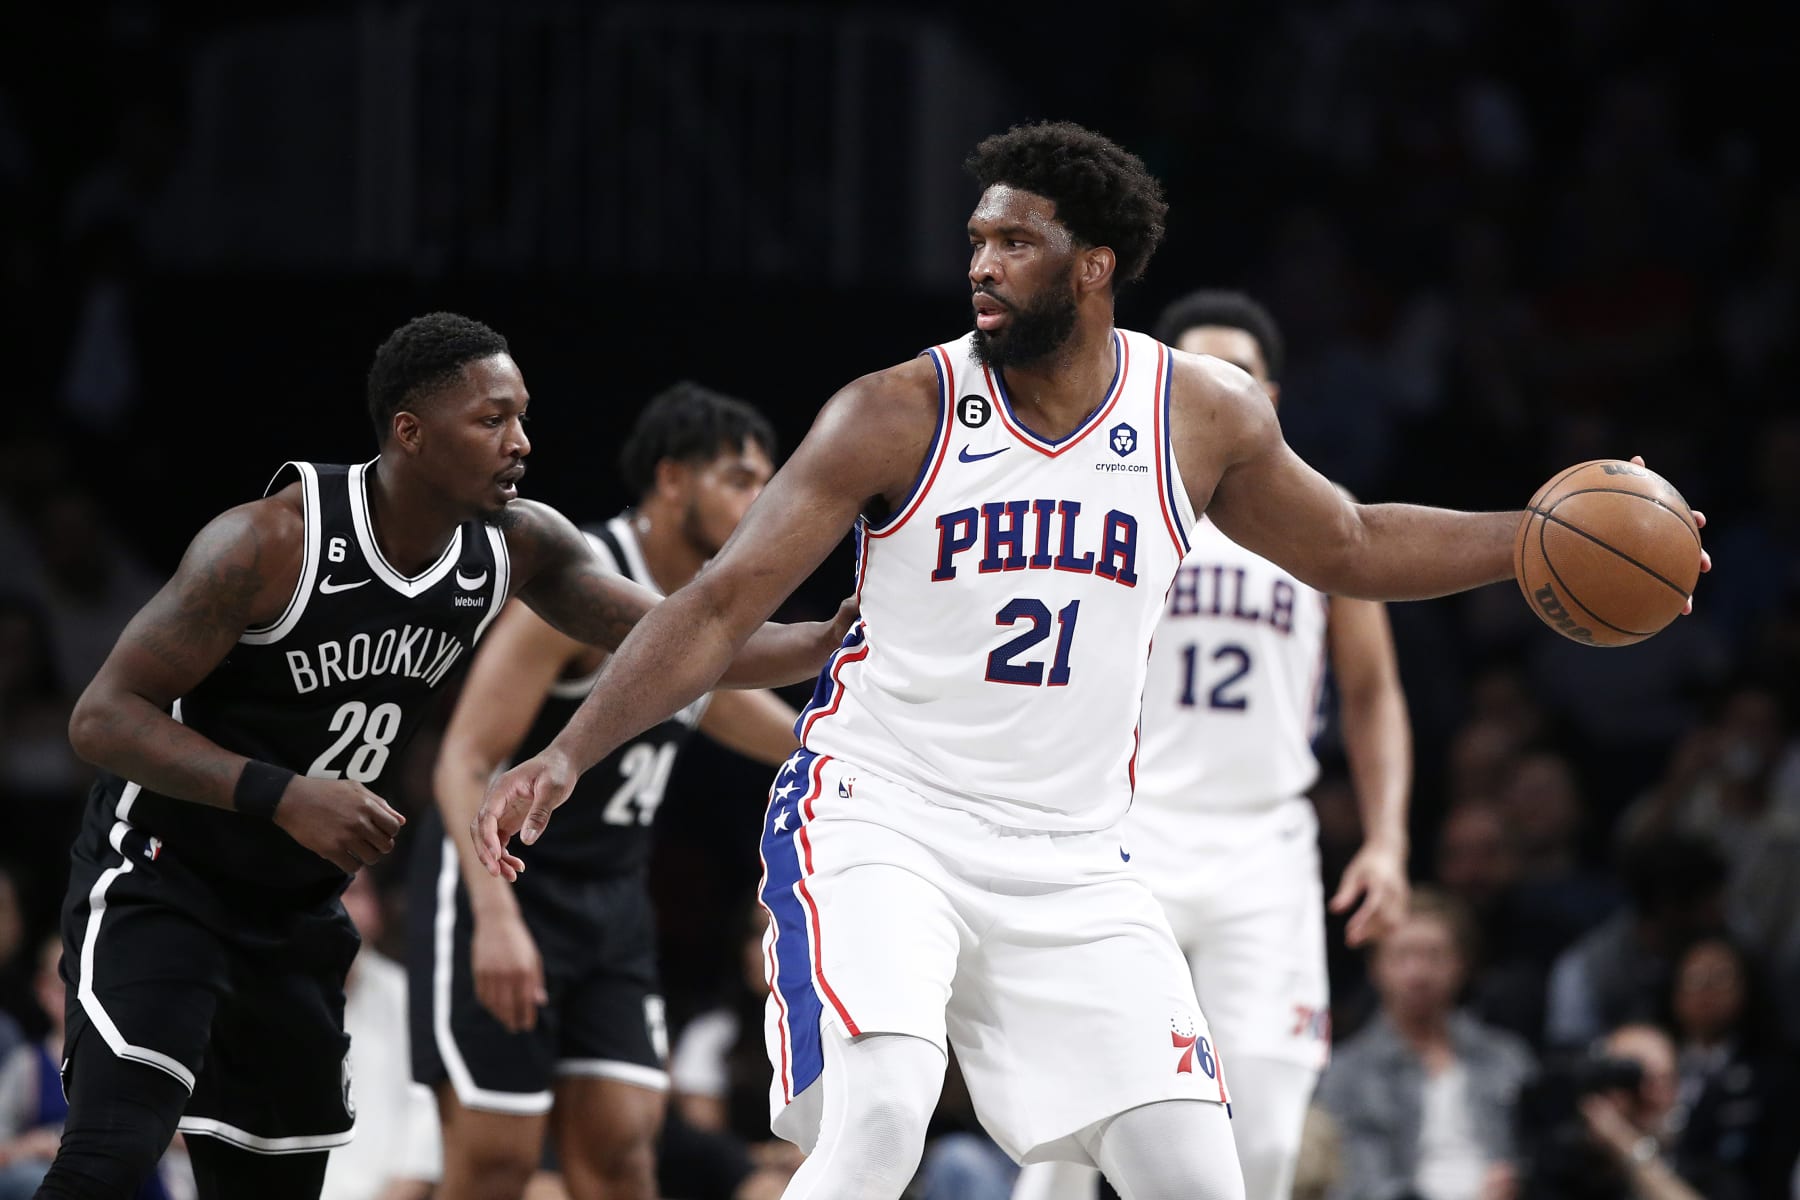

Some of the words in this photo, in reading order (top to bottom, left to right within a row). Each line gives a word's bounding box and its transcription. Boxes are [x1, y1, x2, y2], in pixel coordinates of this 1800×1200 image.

[965, 400, 982, 425] 6
[1095, 463, 1149, 473] crypto.com
[327, 537, 347, 562] 6
[931, 499, 1138, 588] PHILA
[454, 596, 484, 607] Webull
[1168, 565, 1296, 636] HILA
[286, 624, 463, 693] BROOKLYN
[984, 598, 1080, 686] 21
[1178, 640, 1252, 710] 12
[305, 701, 402, 783] 28
[1171, 1031, 1216, 1079] 76
